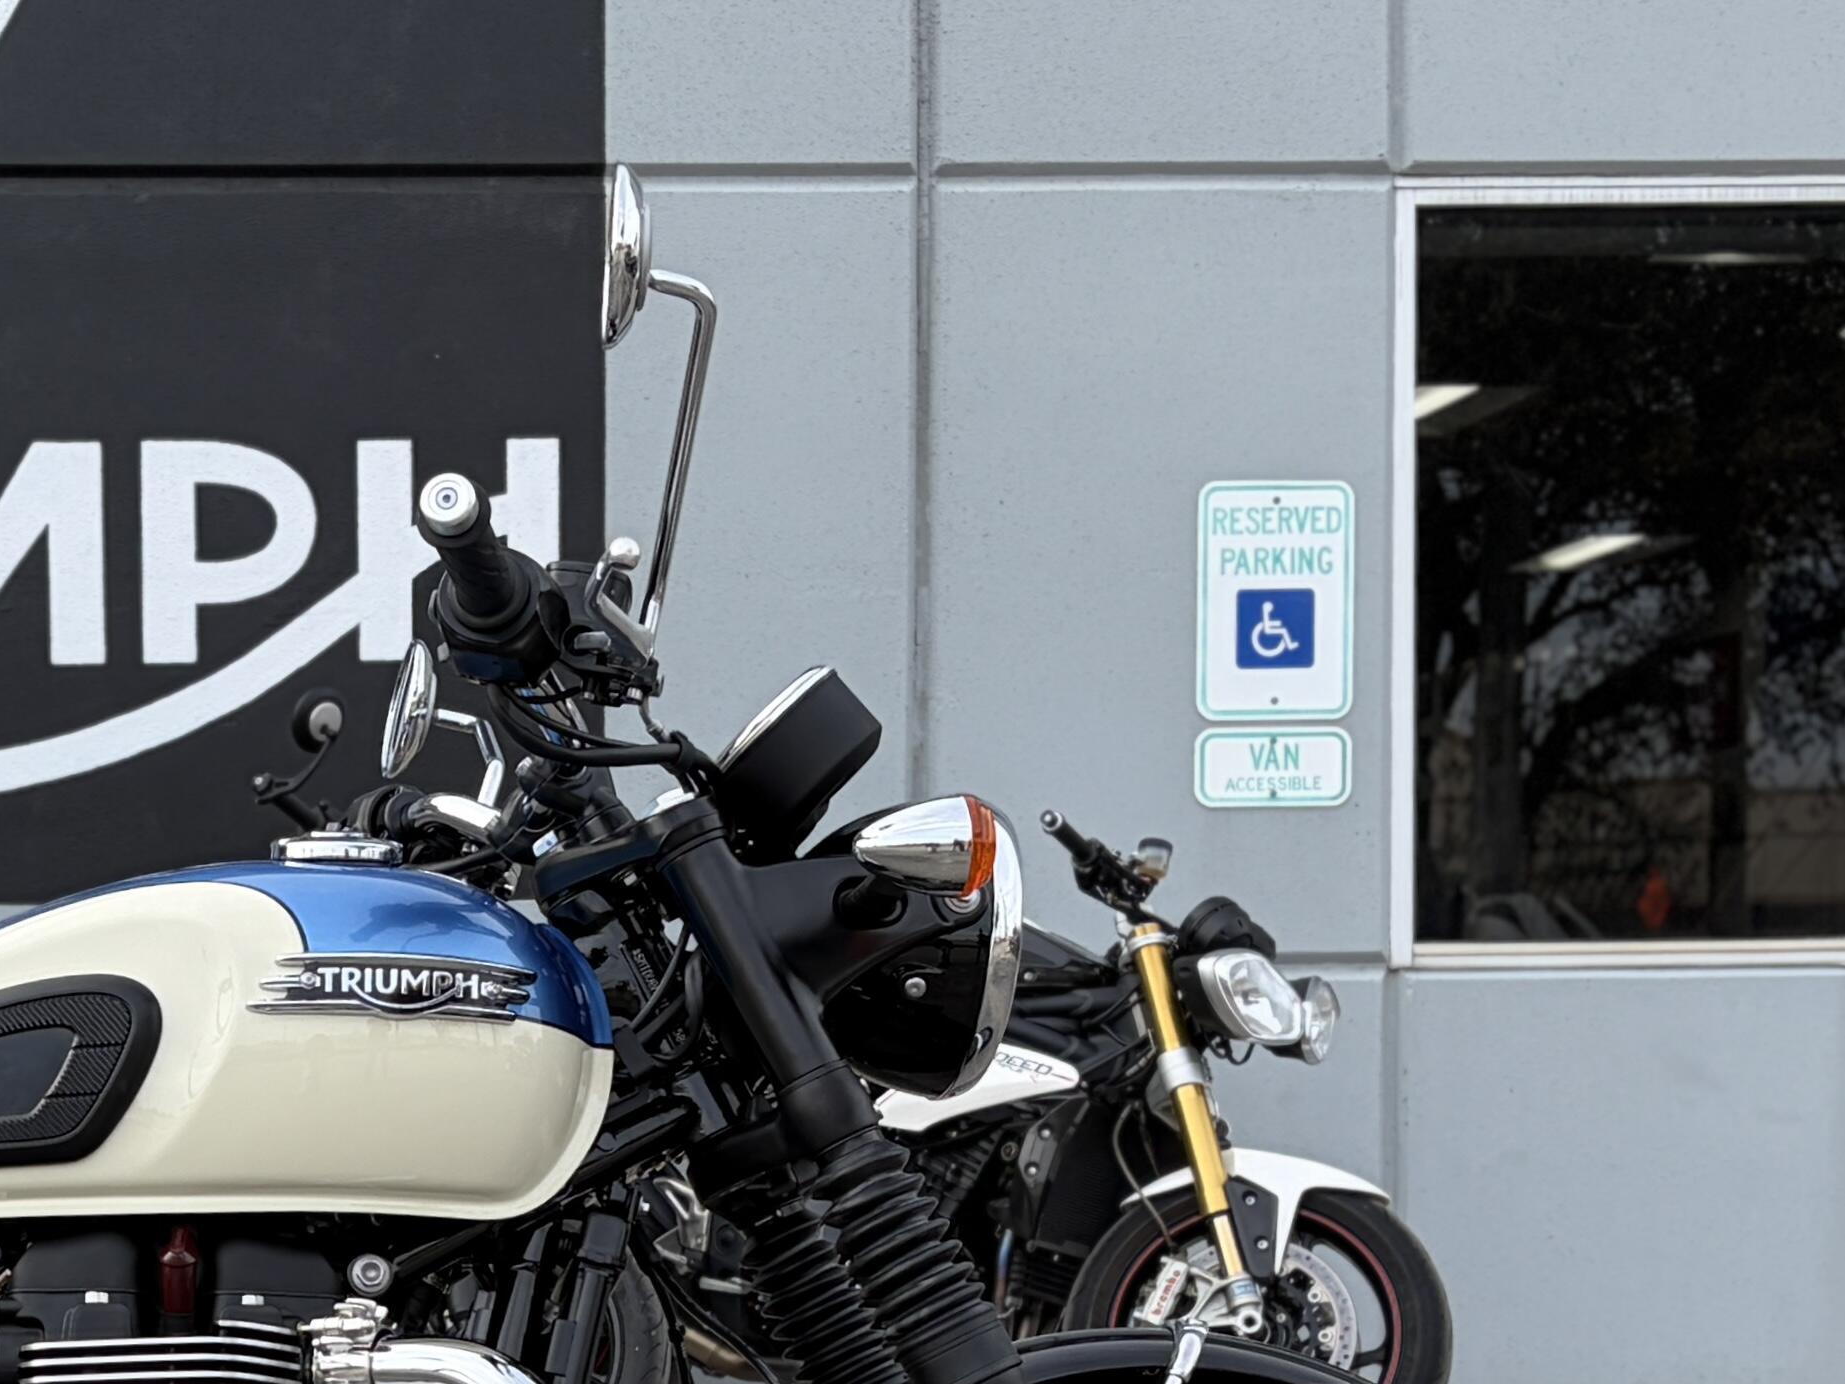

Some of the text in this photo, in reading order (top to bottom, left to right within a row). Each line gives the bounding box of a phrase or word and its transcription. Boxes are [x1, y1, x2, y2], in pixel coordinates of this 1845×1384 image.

[1212, 506, 1342, 536] RESERVED
[1220, 546, 1334, 576] PARKING
[1249, 743, 1300, 772] VAN
[1225, 776, 1322, 792] ACCESSIBLE
[317, 967, 480, 1009] TRIUMPH
[1150, 1270, 1181, 1316] brembo
